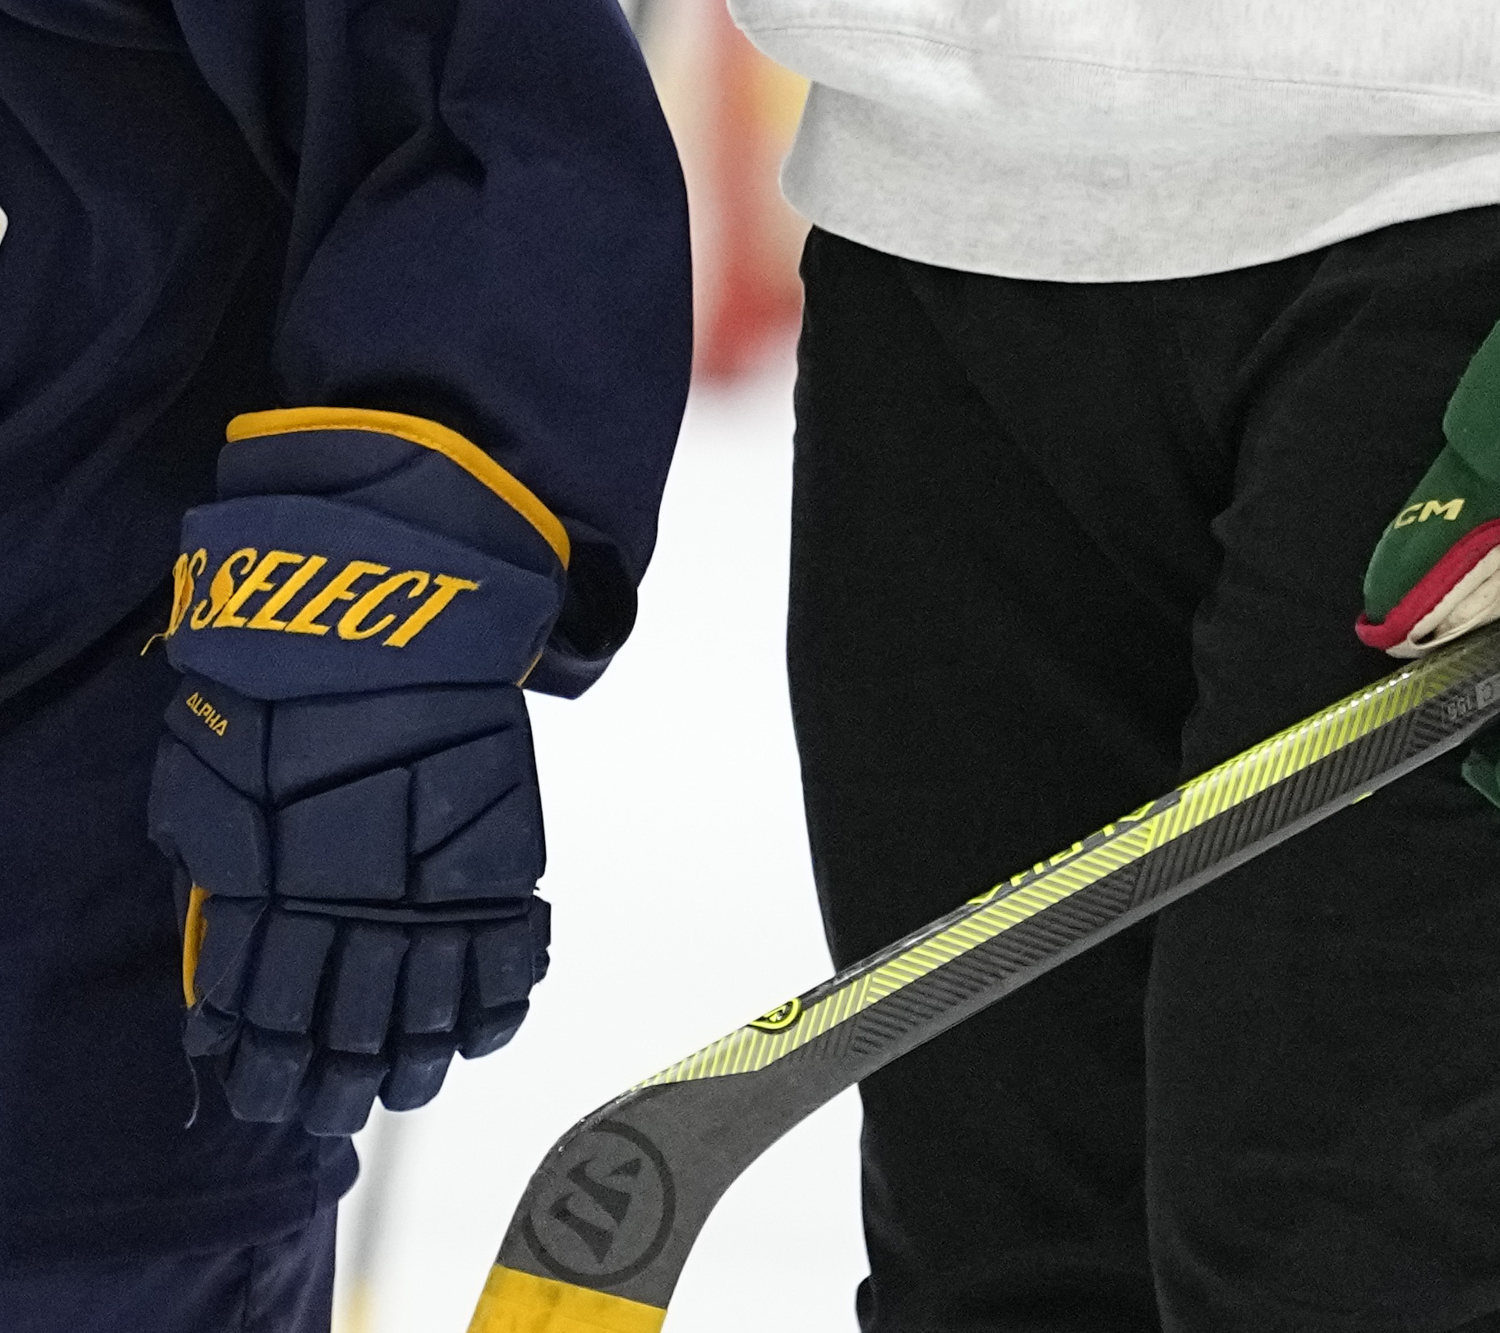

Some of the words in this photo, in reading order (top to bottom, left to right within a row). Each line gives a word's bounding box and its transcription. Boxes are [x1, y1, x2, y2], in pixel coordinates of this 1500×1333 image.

[1393, 497, 1466, 529] CM
[189, 547, 483, 649] SELECT
[186, 690, 229, 738] ALPHA
